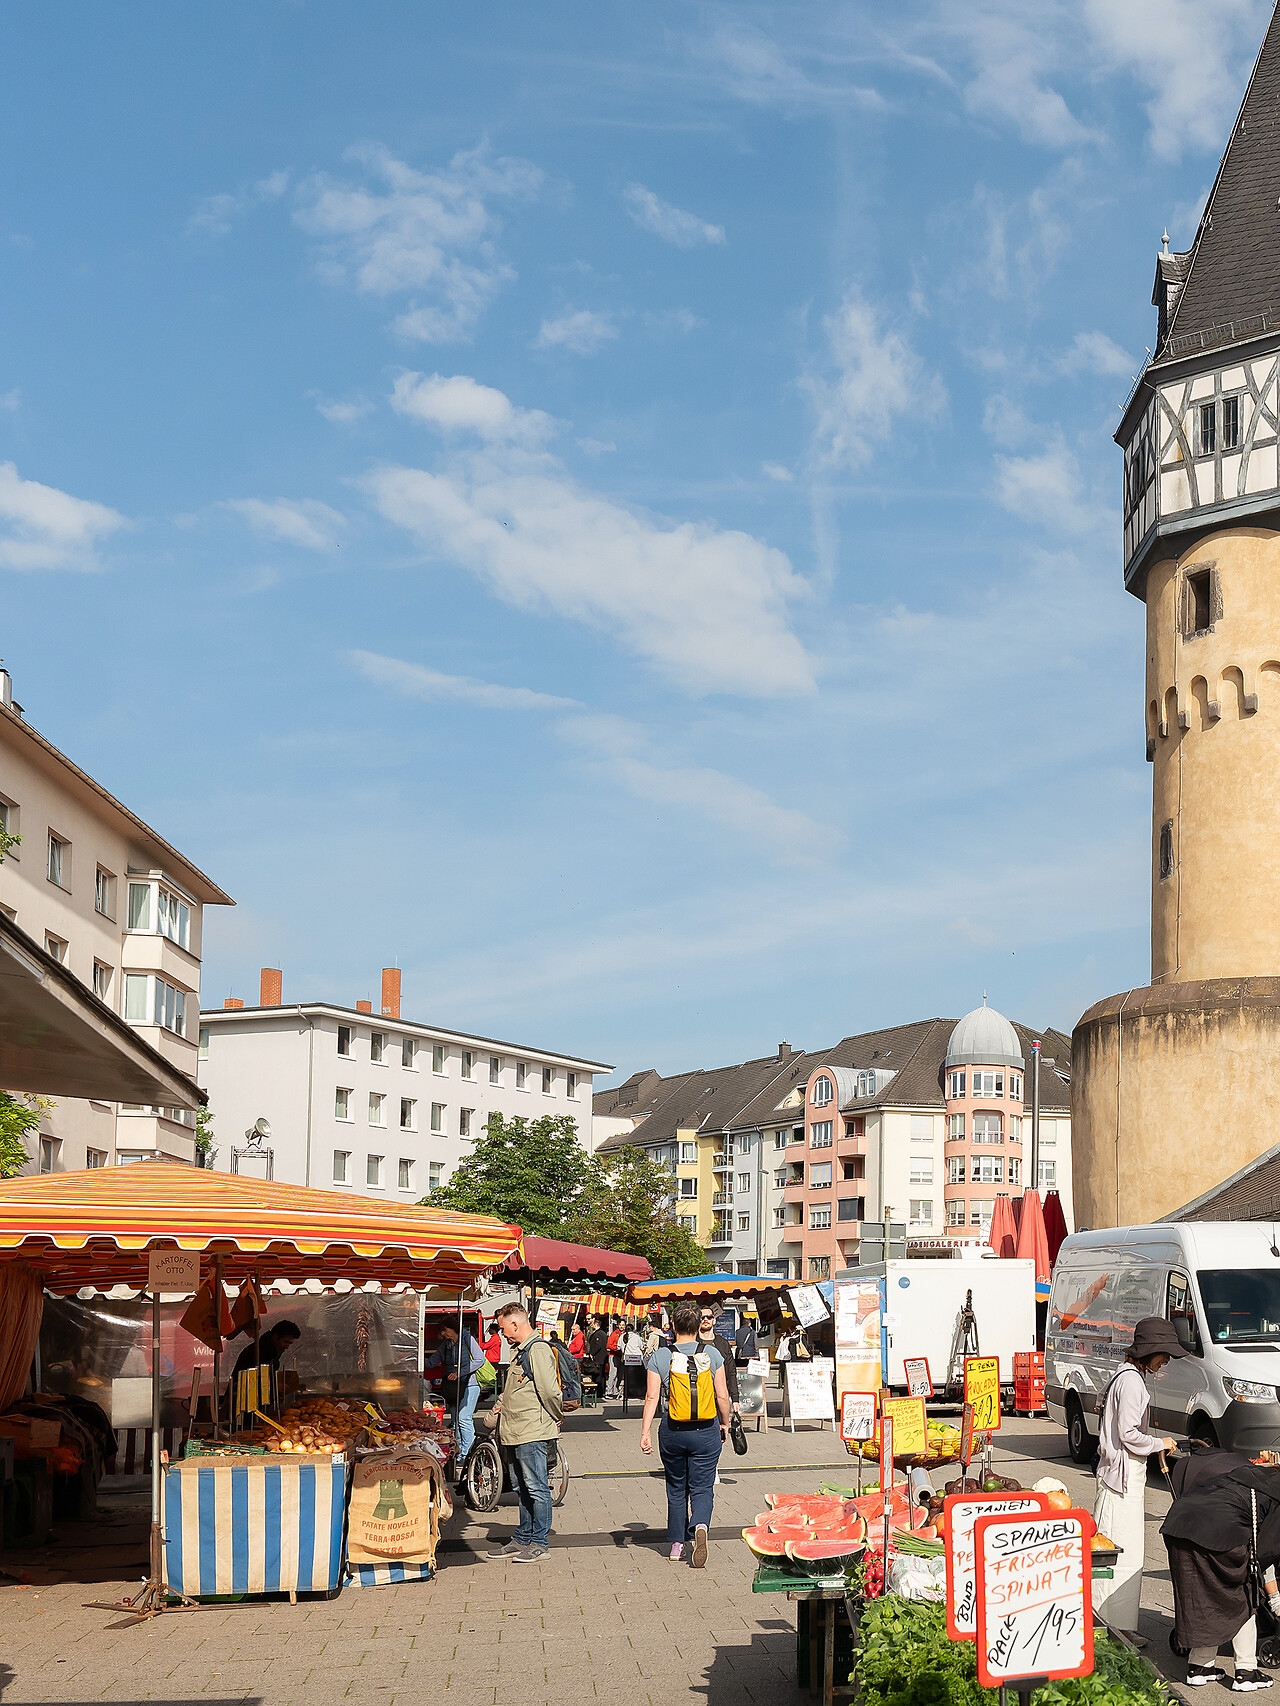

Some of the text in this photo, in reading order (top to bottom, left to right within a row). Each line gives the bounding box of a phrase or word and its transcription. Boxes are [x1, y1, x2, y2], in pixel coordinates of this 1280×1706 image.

[155, 1255, 195, 1271] KARTOFFEL
[165, 1266, 185, 1275] OTTO
[961, 1499, 1031, 1517] SPANIEN
[361, 1517, 419, 1531] PATATE NOVELLE
[364, 1530, 415, 1543] TERRA ROSSA
[992, 1521, 1075, 1549] SPANIEN
[988, 1542, 1083, 1576] FRISCHER
[986, 1566, 1071, 1605] SPINAT
